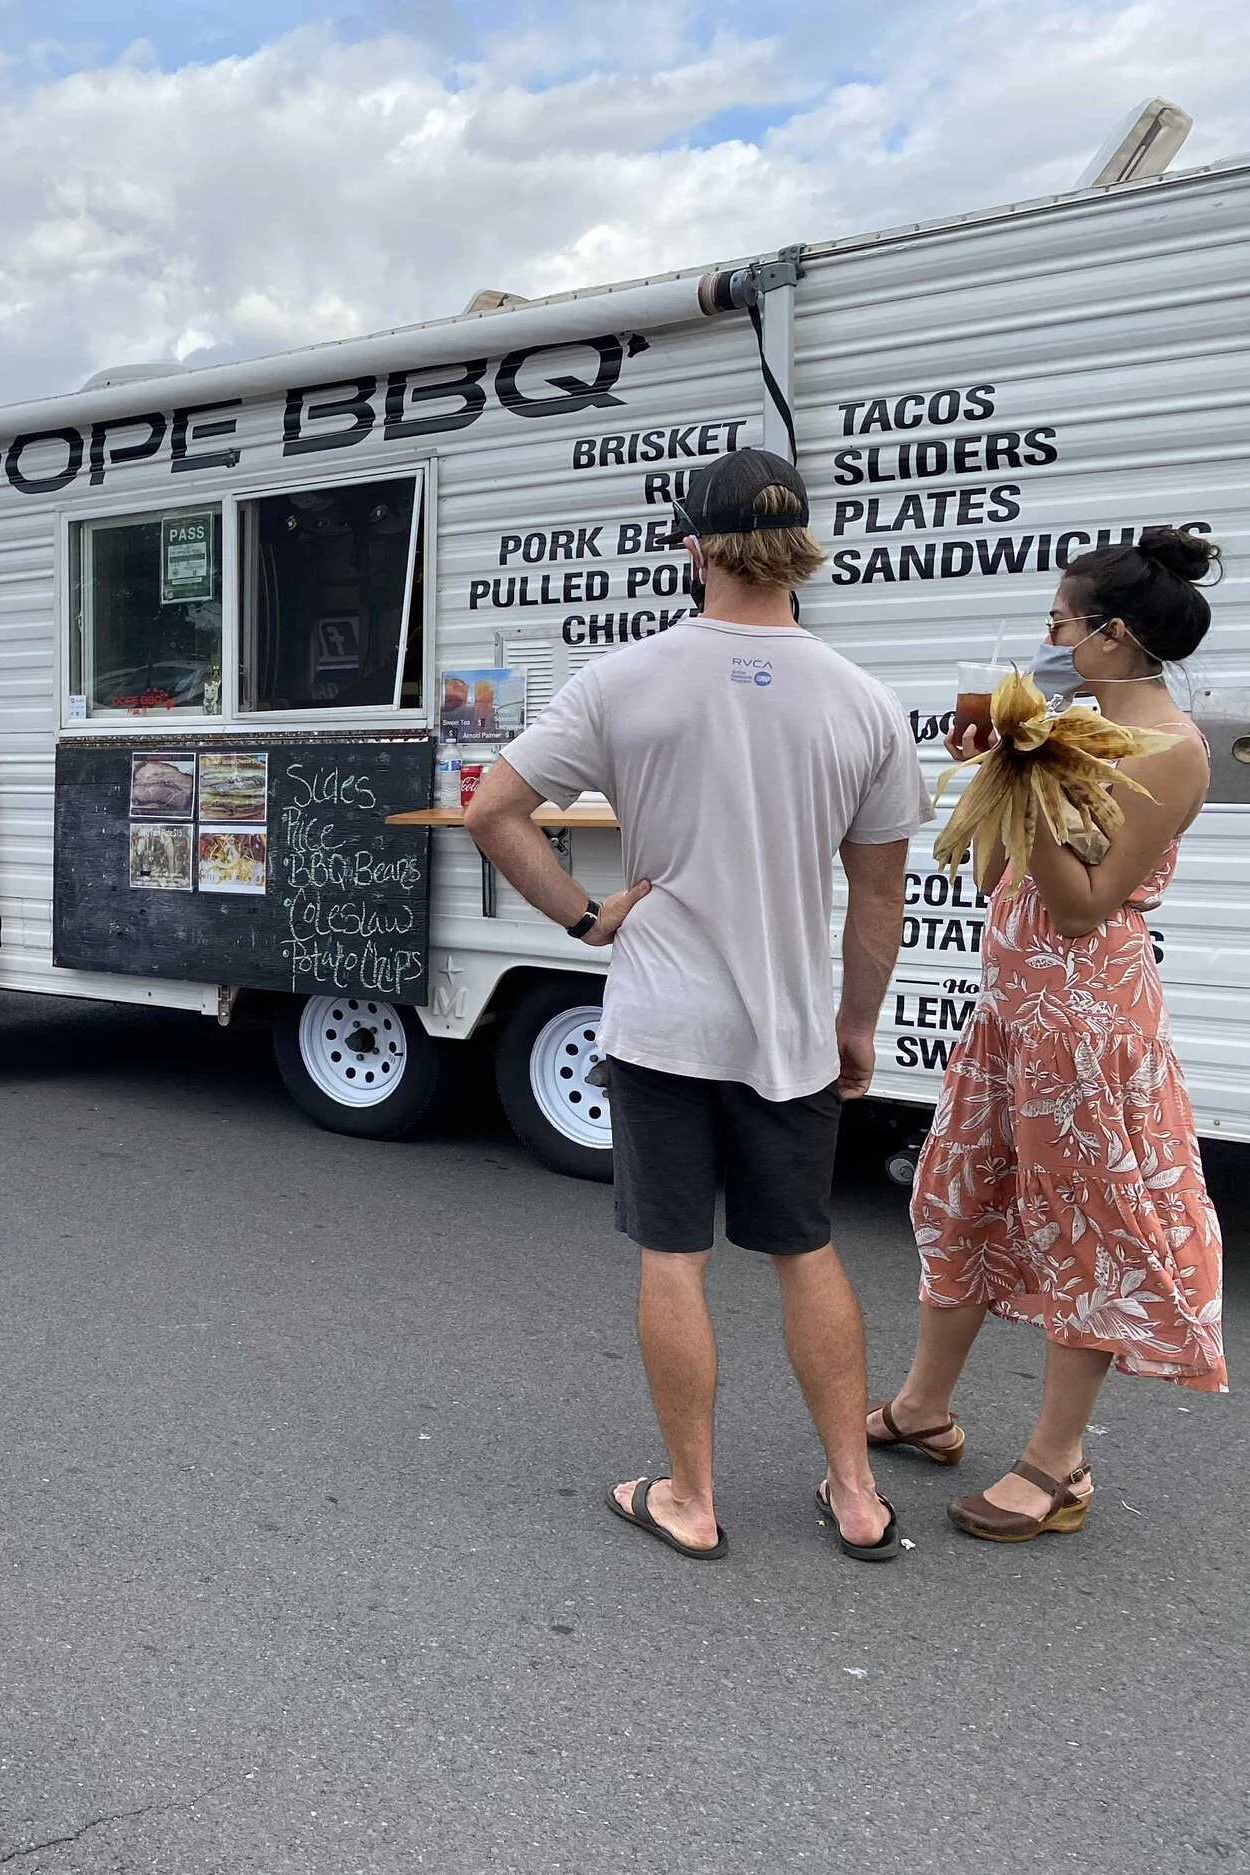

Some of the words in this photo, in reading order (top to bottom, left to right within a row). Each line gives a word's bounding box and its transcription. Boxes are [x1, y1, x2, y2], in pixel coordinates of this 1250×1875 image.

[282, 333, 628, 457] BBQ
[838, 385, 995, 437] TACOS
[573, 420, 747, 470] BRISKET
[834, 427, 1058, 486] SLIDERS
[833, 484, 1021, 537] PLATES
[170, 526, 205, 542] PASS
[499, 526, 604, 566] PORK
[470, 570, 610, 610] PULLED
[562, 607, 700, 645] CHICK
[462, 731, 481, 739] Arnold
[481, 731, 501, 739] Palmer
[287, 764, 376, 808] Sides
[283, 806, 346, 853] Rice
[288, 851, 347, 891] BBQ
[901, 917, 984, 952] OTAT
[281, 940, 358, 993] Potato
[943, 978, 979, 994] Ho
[895, 995, 976, 1031] LEM
[896, 1036, 958, 1071] SW
